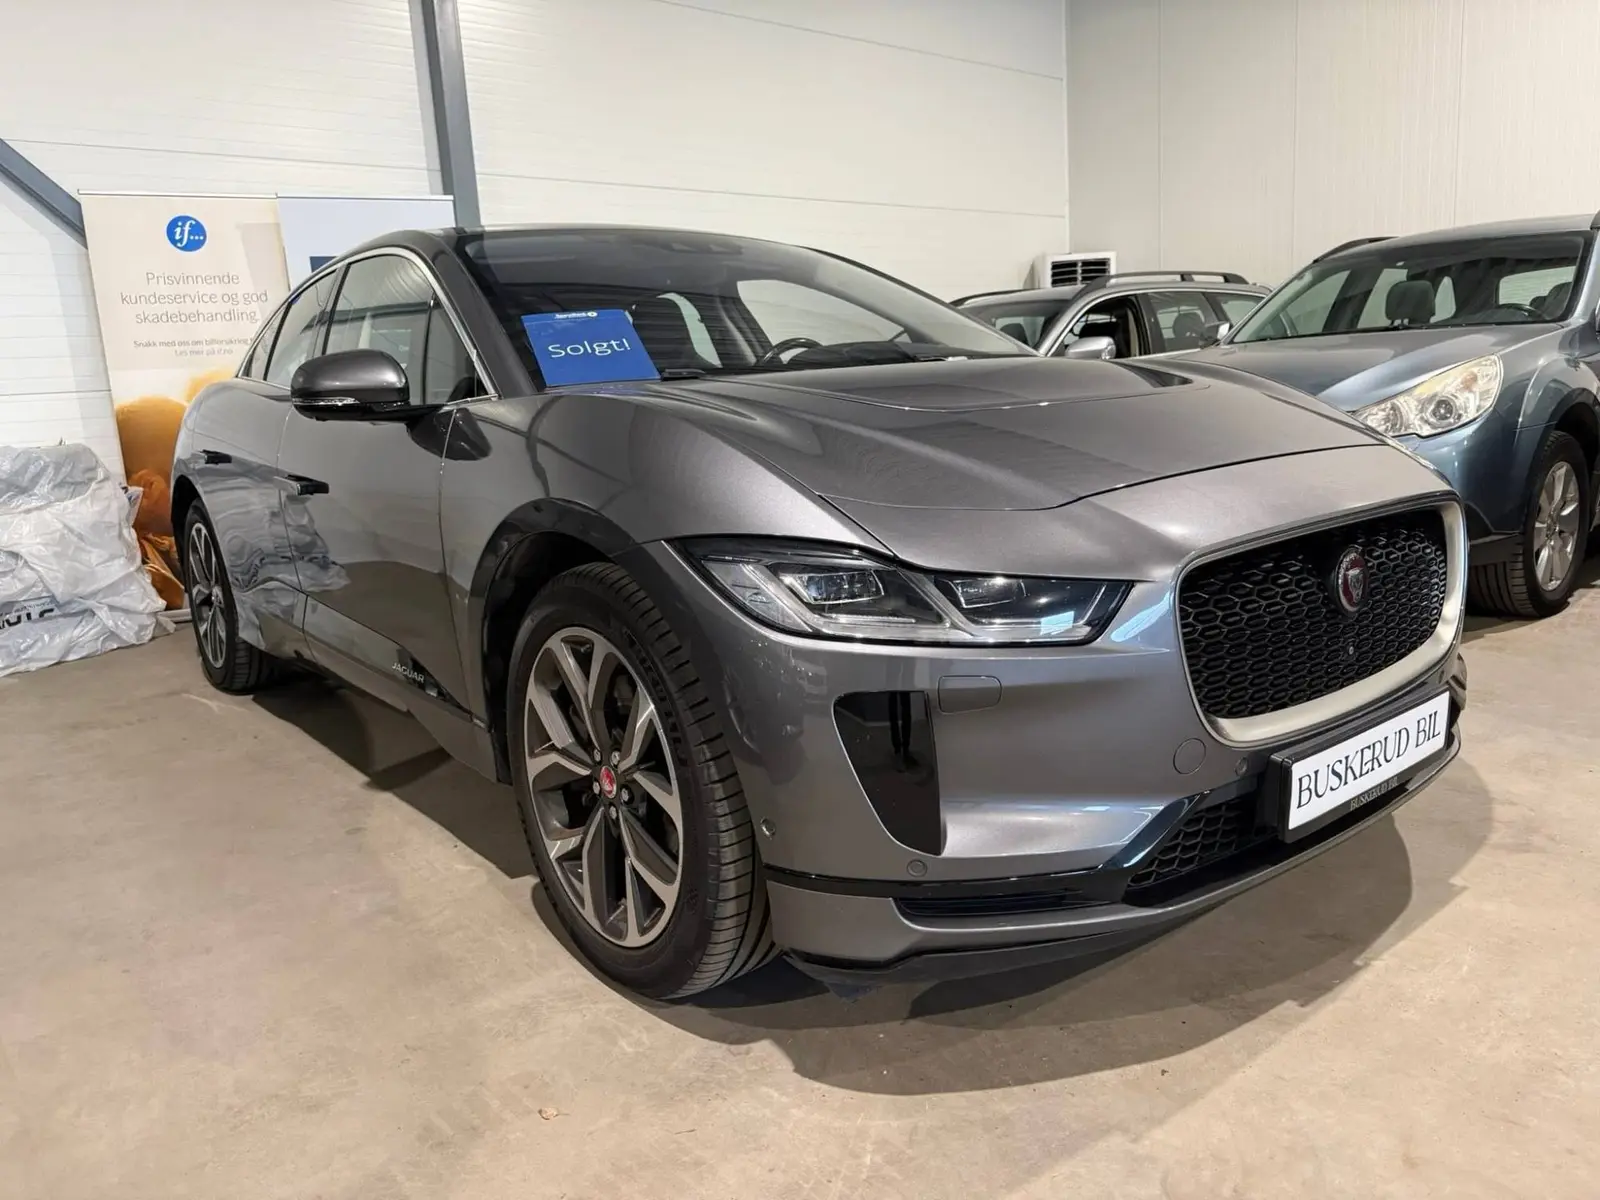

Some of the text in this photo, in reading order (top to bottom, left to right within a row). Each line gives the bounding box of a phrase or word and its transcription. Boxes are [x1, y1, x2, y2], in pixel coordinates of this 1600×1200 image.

[146, 271, 240, 285] Prisvinnende
[120, 290, 269, 305] kundeservice og god
[133, 340, 158, 348] Snakk
[159, 339, 176, 347] med
[548, 338, 631, 358] Solgt!
[392, 662, 425, 683] JAGUAR
[1297, 711, 1440, 809] BUSKERUD BIL
[1350, 782, 1388, 811] BUSKERUD
